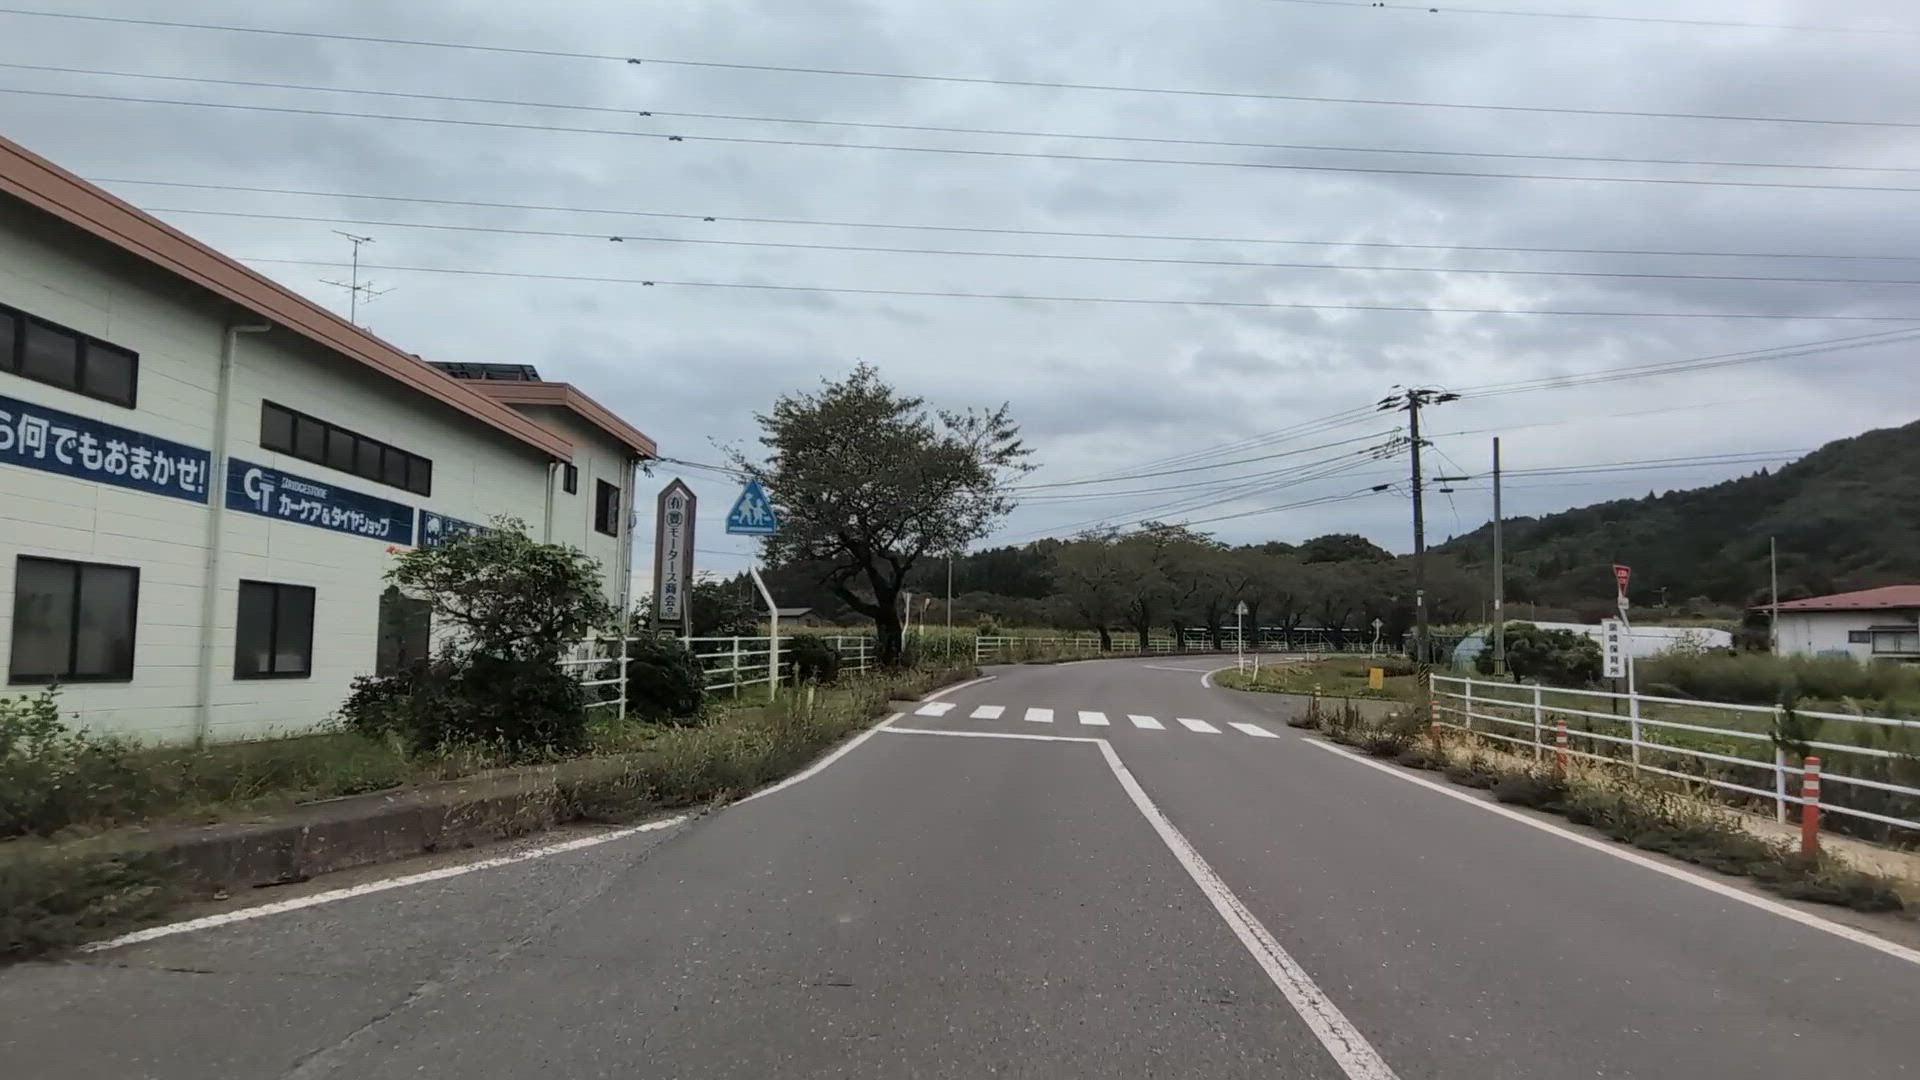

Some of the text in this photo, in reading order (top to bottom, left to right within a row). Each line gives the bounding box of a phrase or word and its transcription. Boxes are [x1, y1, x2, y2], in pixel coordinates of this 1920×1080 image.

[281, 477, 329, 499] BRIDGESTONE
[278, 493, 390, 537] カーケア&タイヤショップ
